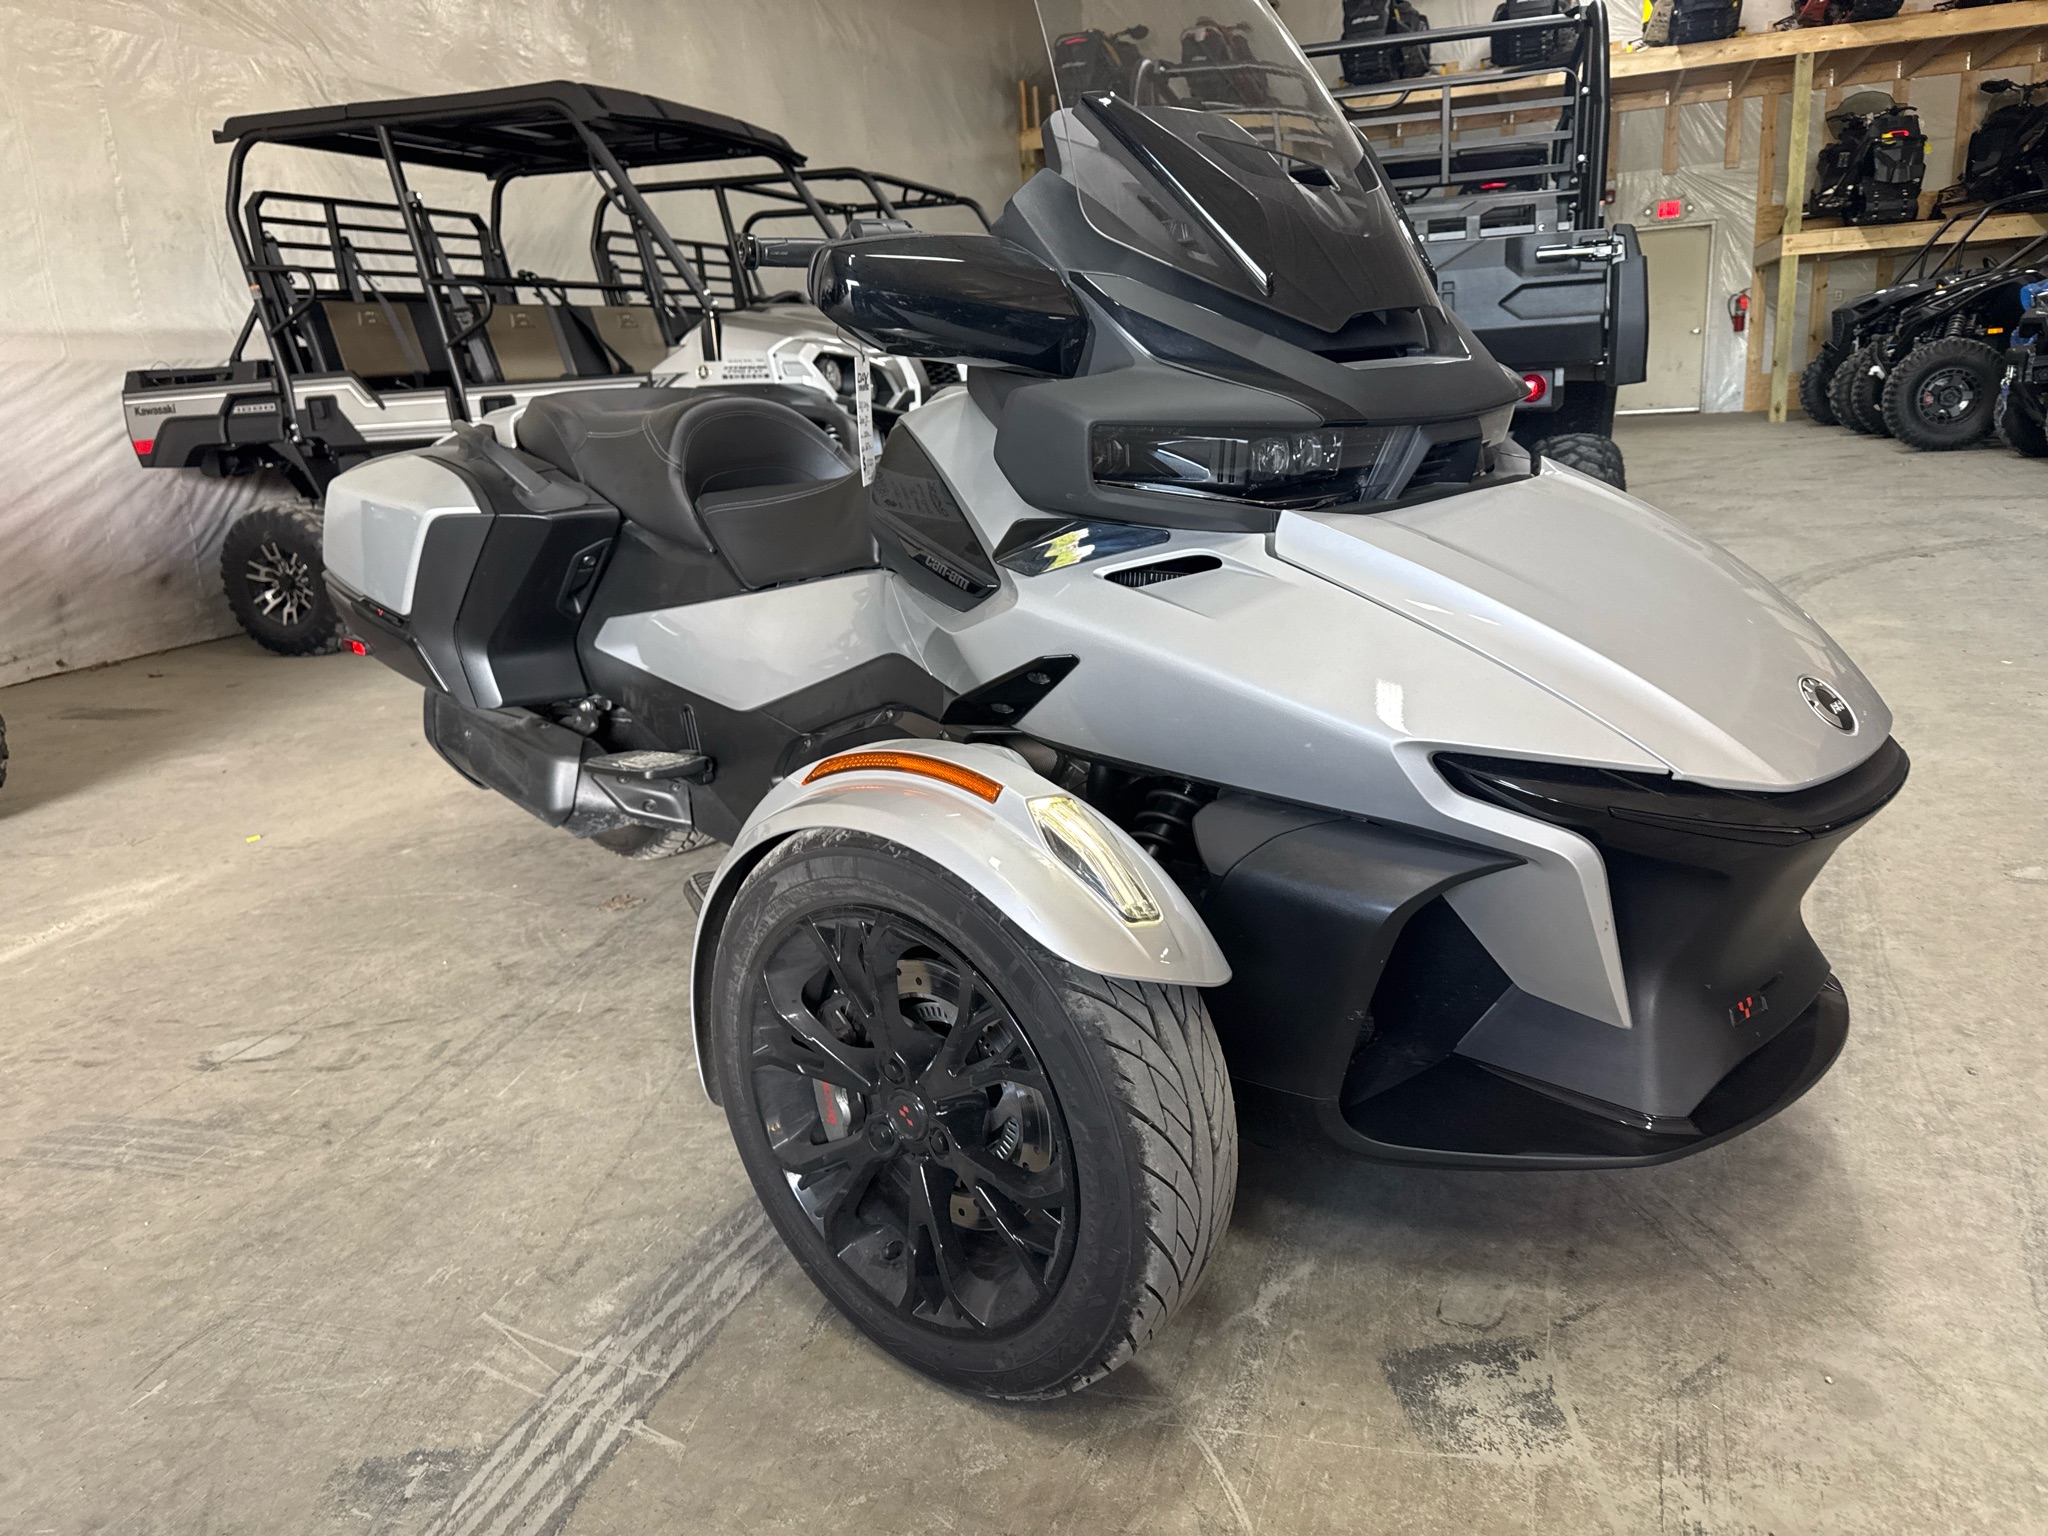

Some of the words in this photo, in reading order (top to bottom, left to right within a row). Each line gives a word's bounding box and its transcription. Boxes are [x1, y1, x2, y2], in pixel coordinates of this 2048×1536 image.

[857, 372, 870, 385] DAY
[134, 403, 176, 416] Kawasaki
[925, 555, 970, 590] can-am
